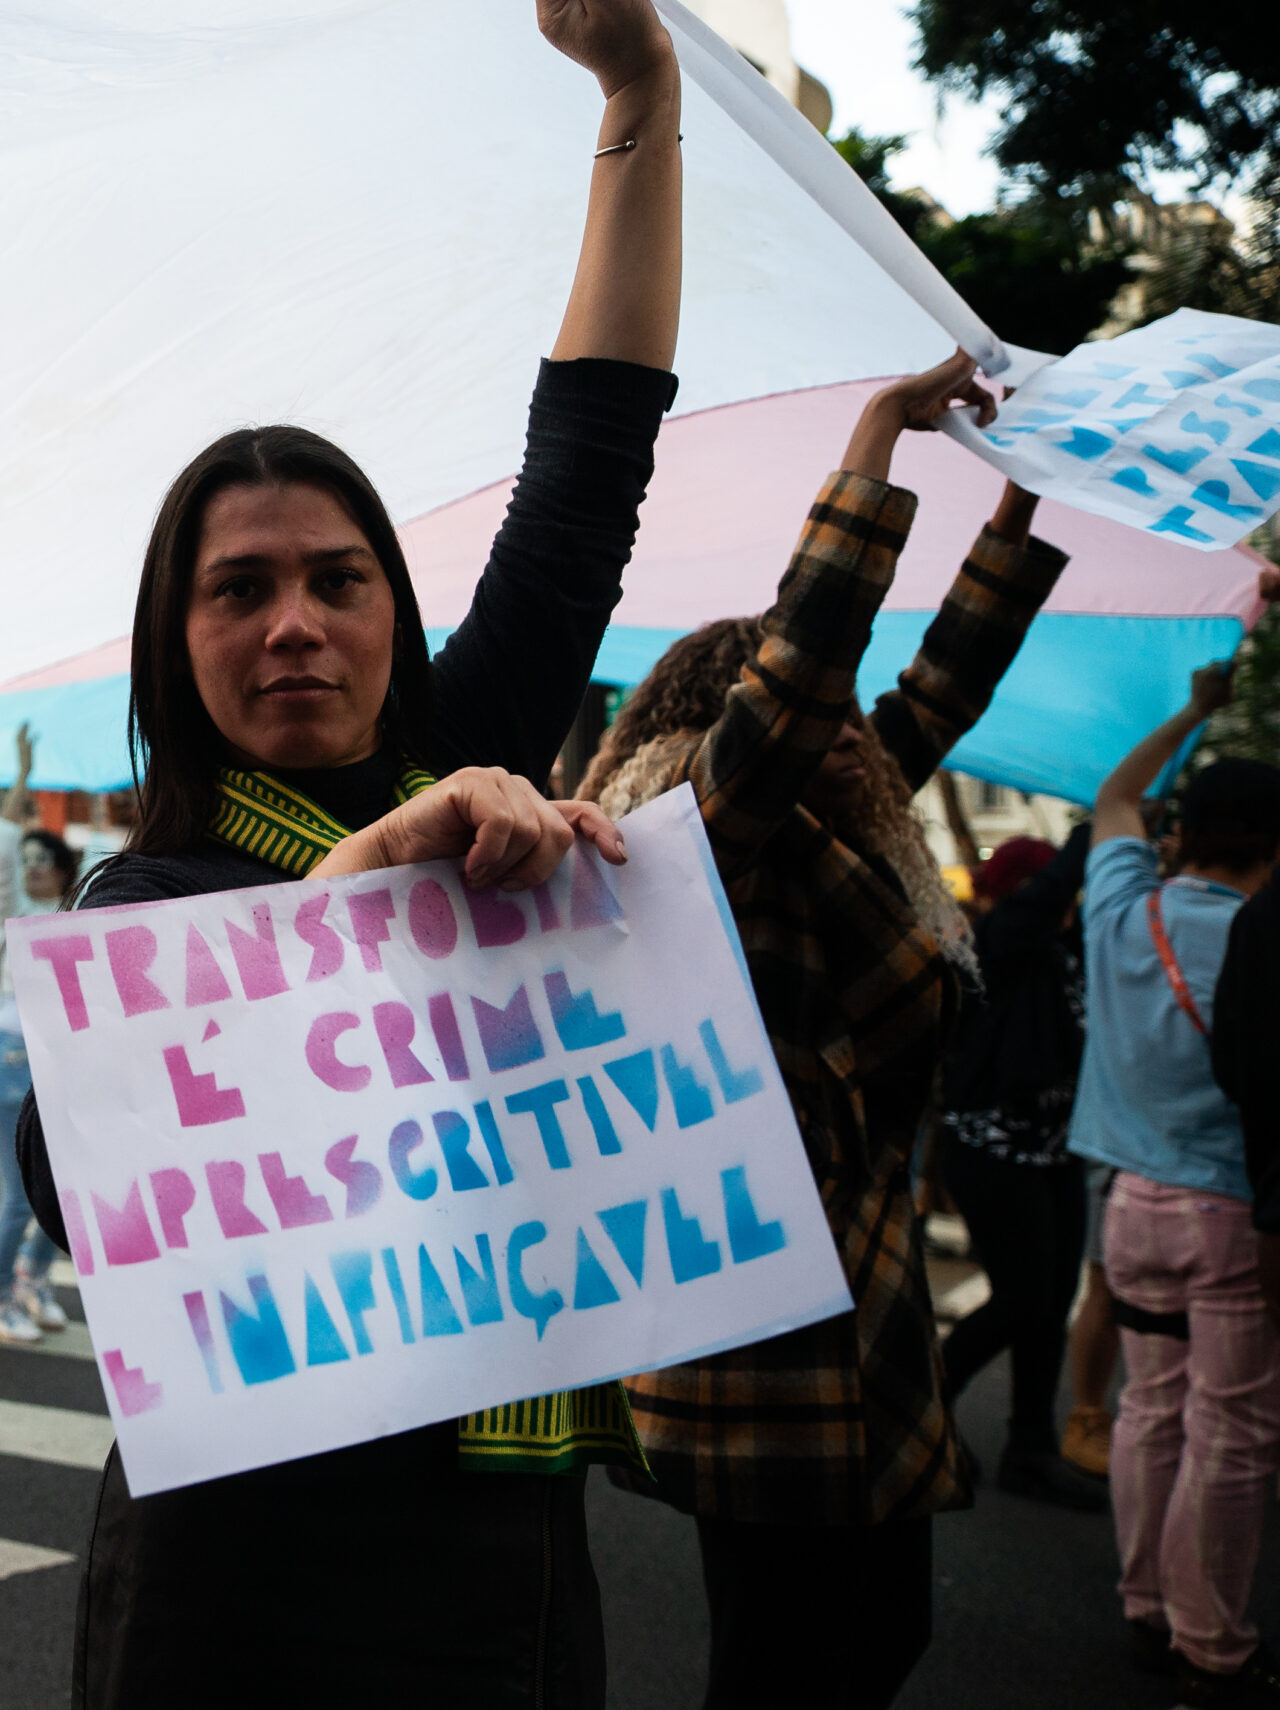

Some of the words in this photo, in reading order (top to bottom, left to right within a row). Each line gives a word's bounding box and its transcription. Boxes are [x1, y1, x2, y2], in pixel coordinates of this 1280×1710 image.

[1110, 365, 1280, 498] PESSO
[1146, 422, 1280, 543] TRAV
[30, 846, 626, 1032] TRANSFOBIA
[162, 1018, 246, 1128] É
[305, 970, 626, 1093] CRIME
[60, 1018, 765, 1276] IMPRESCRITIVEL
[103, 1349, 163, 1418] E
[182, 1165, 787, 1395] INAFIANÇAVEL
